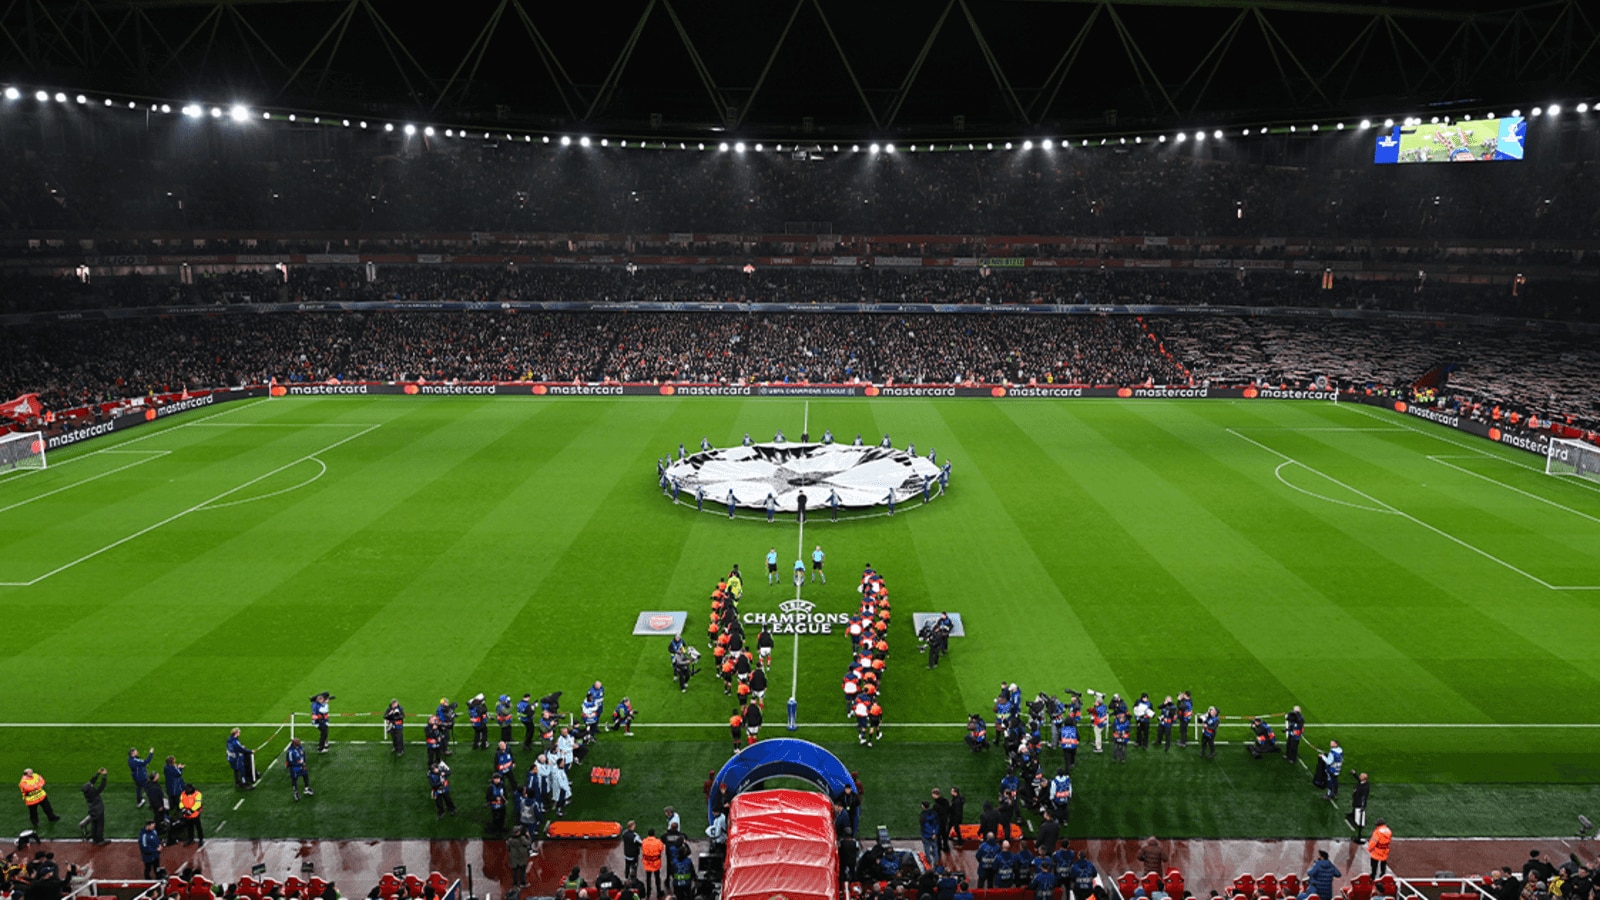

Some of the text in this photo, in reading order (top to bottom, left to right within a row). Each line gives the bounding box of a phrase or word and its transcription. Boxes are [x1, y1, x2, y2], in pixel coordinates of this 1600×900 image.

[290, 385, 367, 394] mastercard
[422, 385, 496, 394] mastercard
[550, 386, 623, 395] mastercard
[678, 386, 750, 395] mastercard
[882, 387, 956, 396] mastercard
[1009, 387, 1082, 396] mastercard
[1135, 388, 1208, 397] mastercard
[1260, 389, 1337, 400] mastercard
[158, 394, 213, 416] mastercard
[1408, 405, 1459, 427] mastercard
[49, 419, 114, 448] mastercard
[1503, 433, 1568, 460] mastercard
[743, 612, 850, 624] CHAMPIONS
